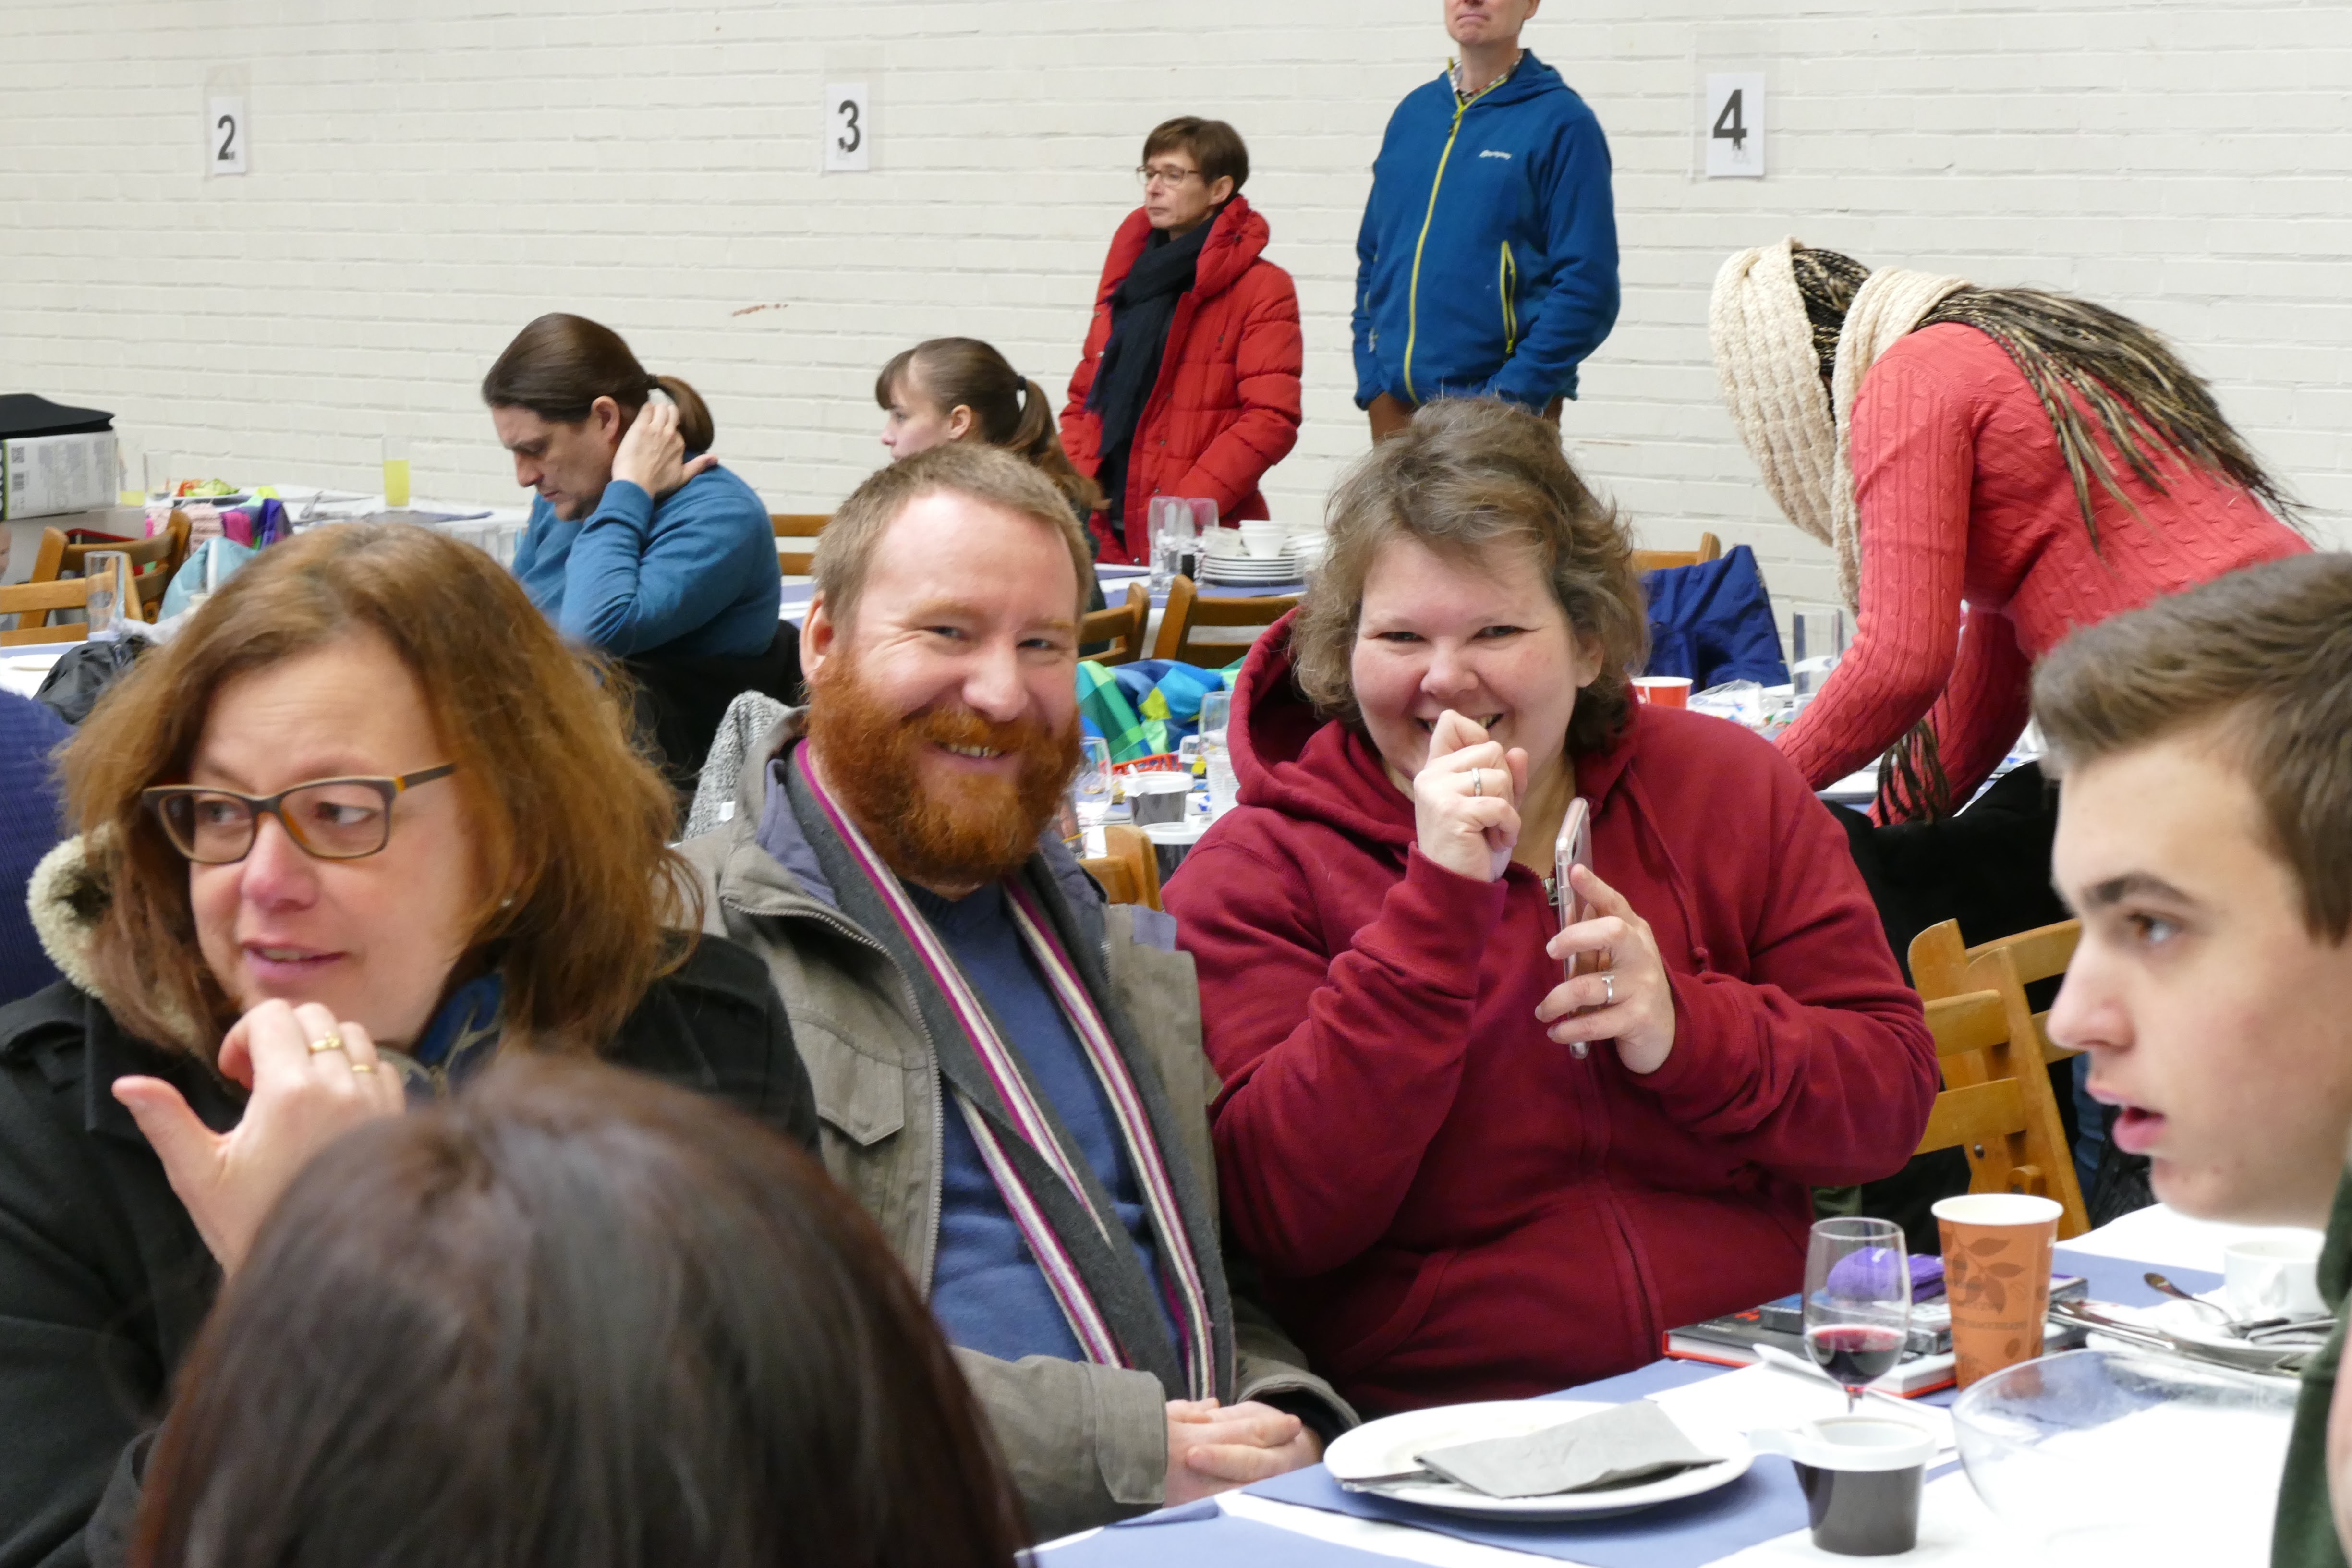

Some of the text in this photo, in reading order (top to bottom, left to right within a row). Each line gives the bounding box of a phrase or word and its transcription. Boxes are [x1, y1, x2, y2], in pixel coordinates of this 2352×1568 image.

[217, 114, 235, 160] 2
[838, 99, 861, 153] 3
[1713, 89, 1747, 151] 4
